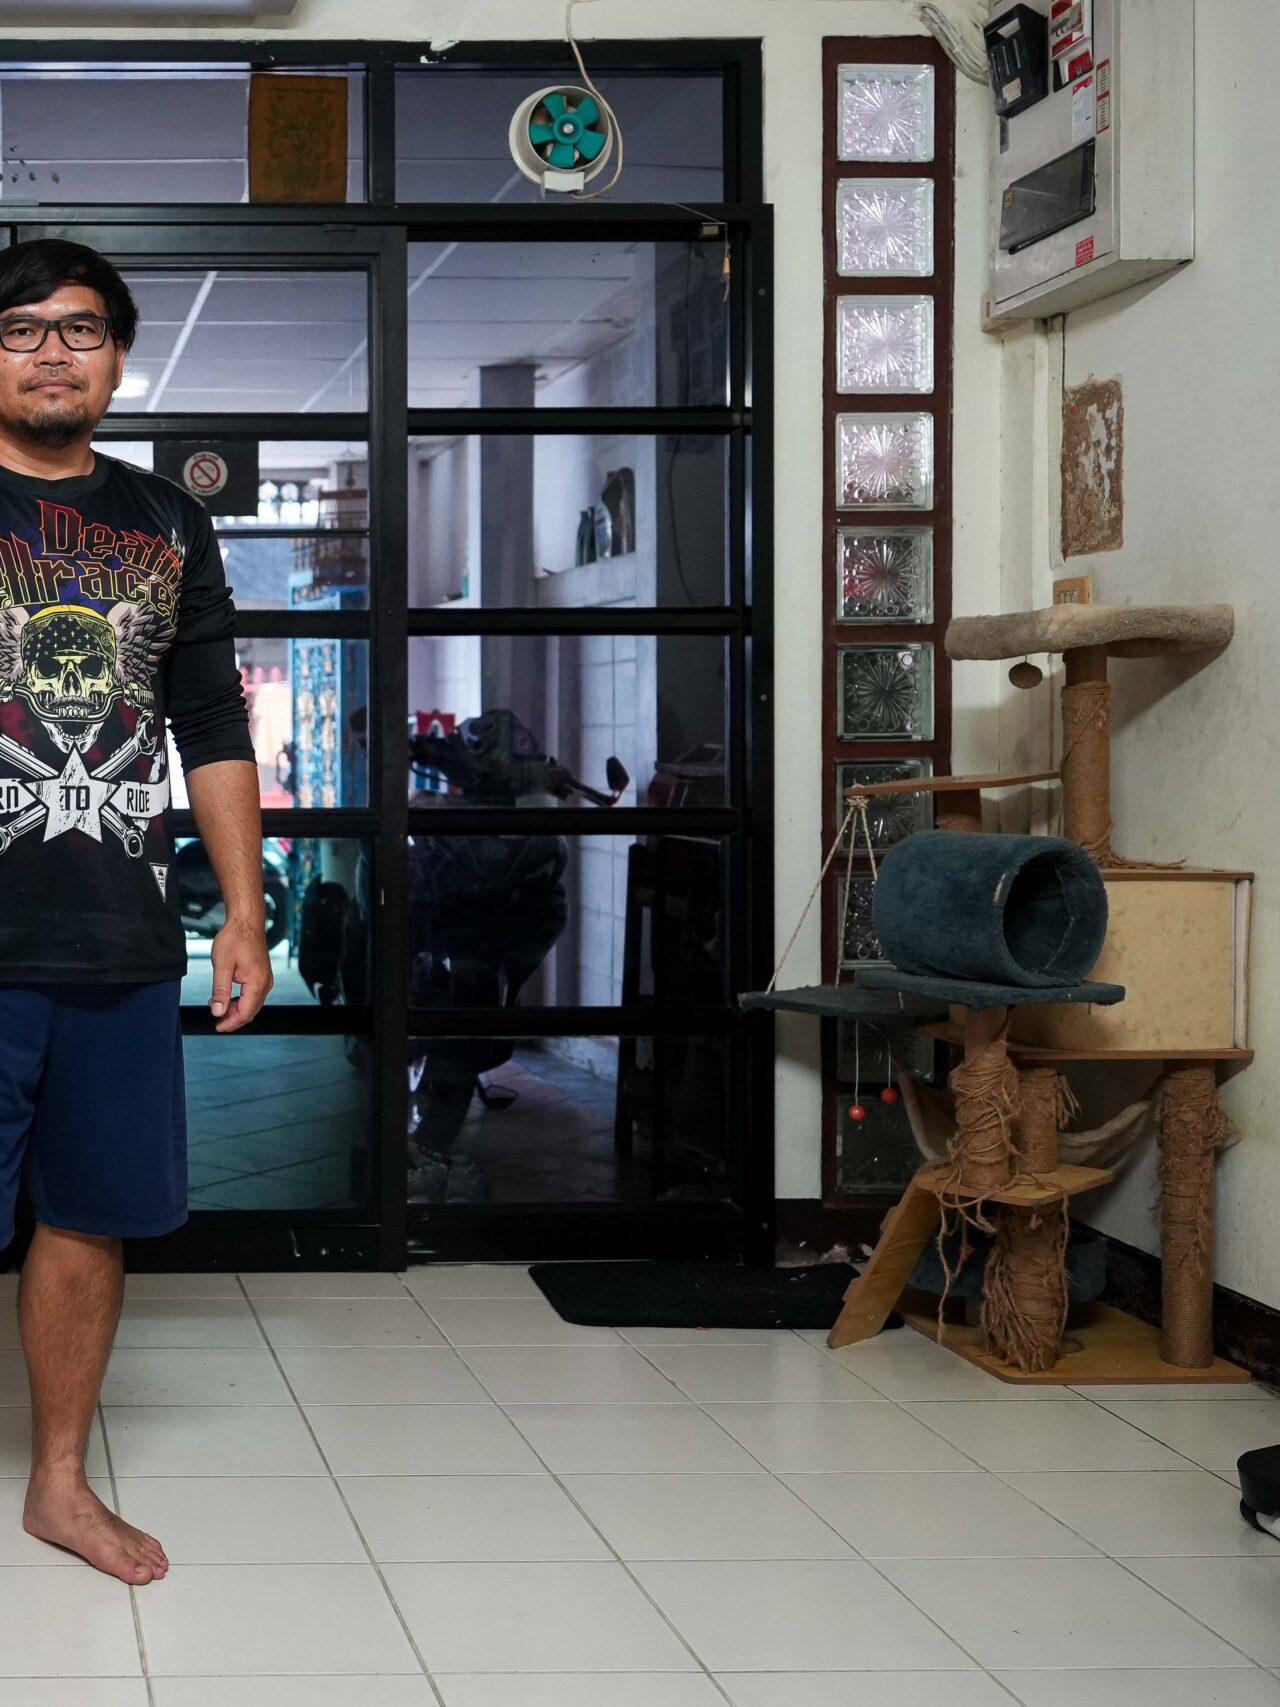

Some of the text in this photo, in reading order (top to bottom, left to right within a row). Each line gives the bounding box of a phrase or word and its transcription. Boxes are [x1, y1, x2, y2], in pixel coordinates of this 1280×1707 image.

[36, 499, 183, 589] Death
[59, 785, 91, 811] TO
[126, 787, 150, 813] RIDE
